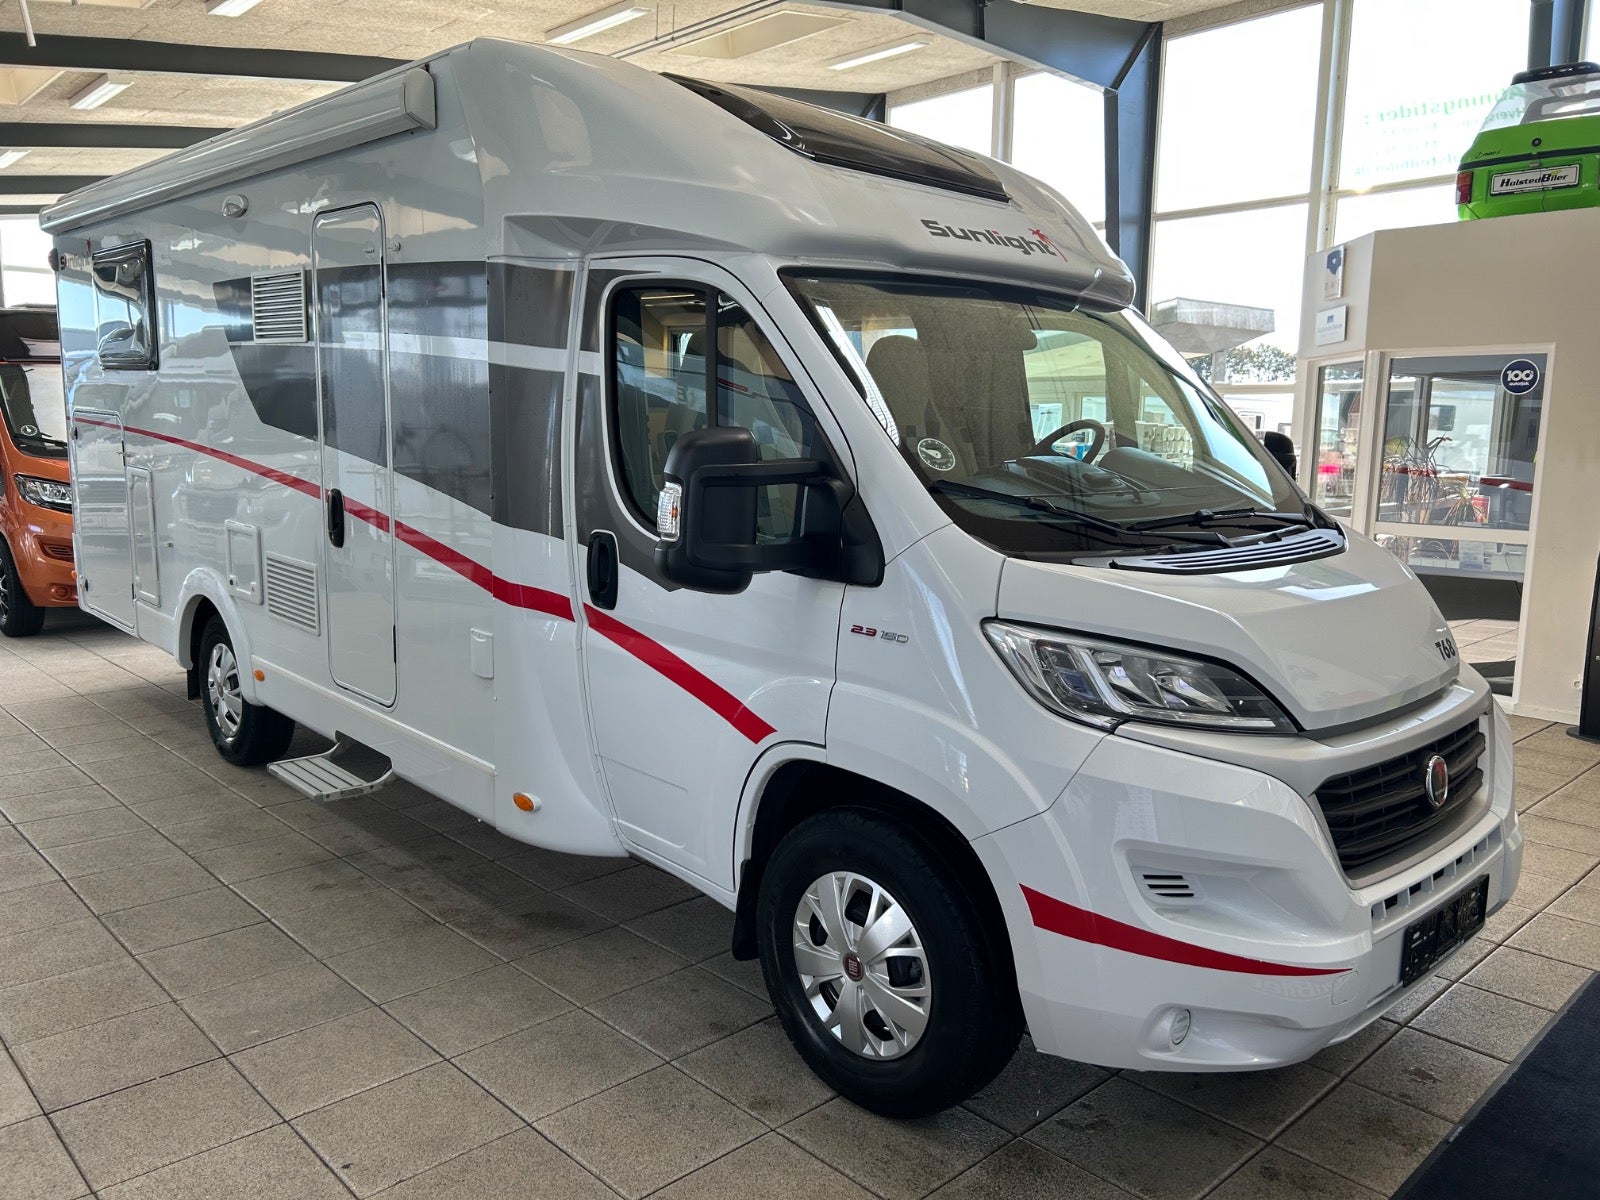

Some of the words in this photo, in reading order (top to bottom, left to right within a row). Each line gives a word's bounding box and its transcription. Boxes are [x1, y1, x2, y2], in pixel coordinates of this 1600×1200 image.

[1500, 173, 1568, 188] HolstedBiler
[920, 219, 1058, 256] Sunlight
[880, 631, 909, 643] 150
[1435, 638, 1456, 660] T68
